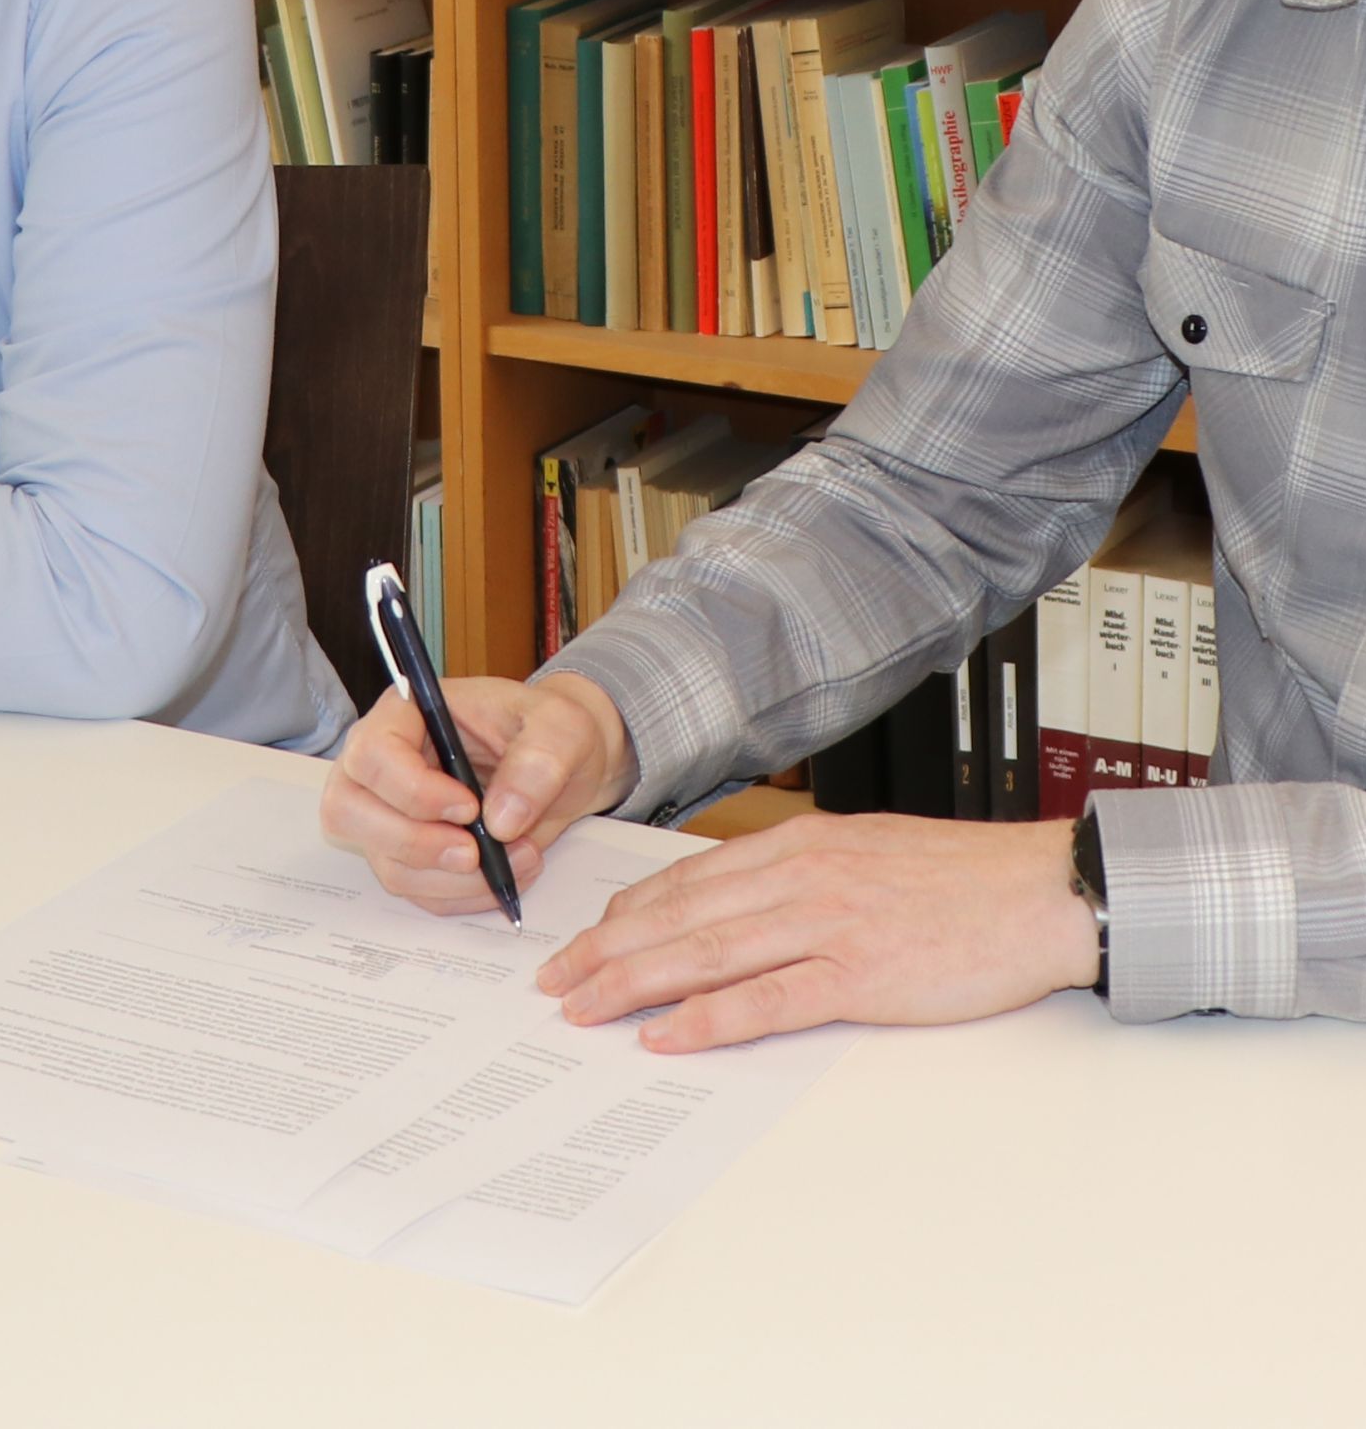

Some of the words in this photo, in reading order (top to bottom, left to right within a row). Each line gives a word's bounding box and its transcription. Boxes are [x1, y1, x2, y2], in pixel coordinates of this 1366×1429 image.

[544, 529, 556, 546] und
[1103, 582, 1129, 595] Lexer
[1154, 590, 1180, 603] Lexer
[1104, 609, 1127, 620] Mhd.
[1103, 620, 1128, 630] Hand-
[1155, 616, 1177, 628] Mhd.
[1099, 630, 1132, 642] wörter-
[1153, 627, 1178, 639] Hand-
[1105, 641, 1126, 652] buch
[1149, 638, 1181, 649] wörter-
[1155, 648, 1176, 660] buch
[962, 764, 970, 785] 2
[1147, 765, 1177, 786] N-U
[1006, 770, 1014, 792] 3
